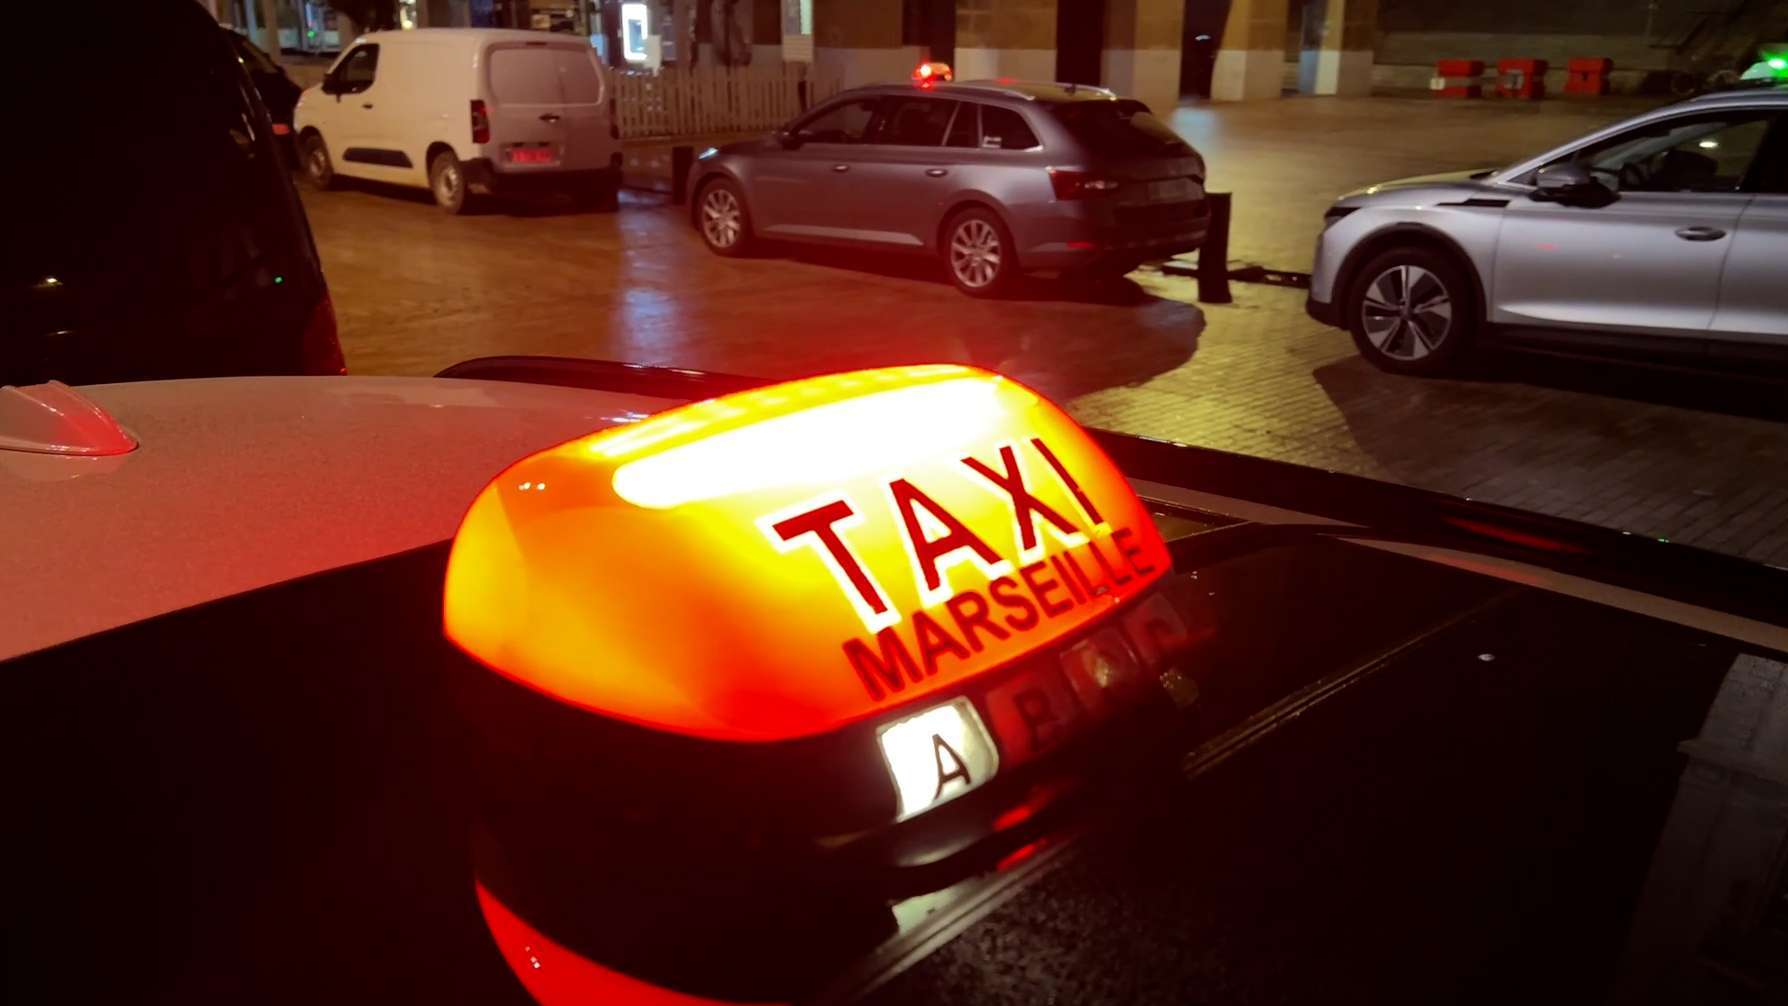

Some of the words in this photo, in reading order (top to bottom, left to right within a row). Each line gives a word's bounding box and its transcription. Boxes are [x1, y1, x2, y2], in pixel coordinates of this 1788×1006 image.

[772, 438, 1104, 615] TAXI
[842, 528, 1155, 701] MARSEILLE
[932, 733, 971, 801] A
